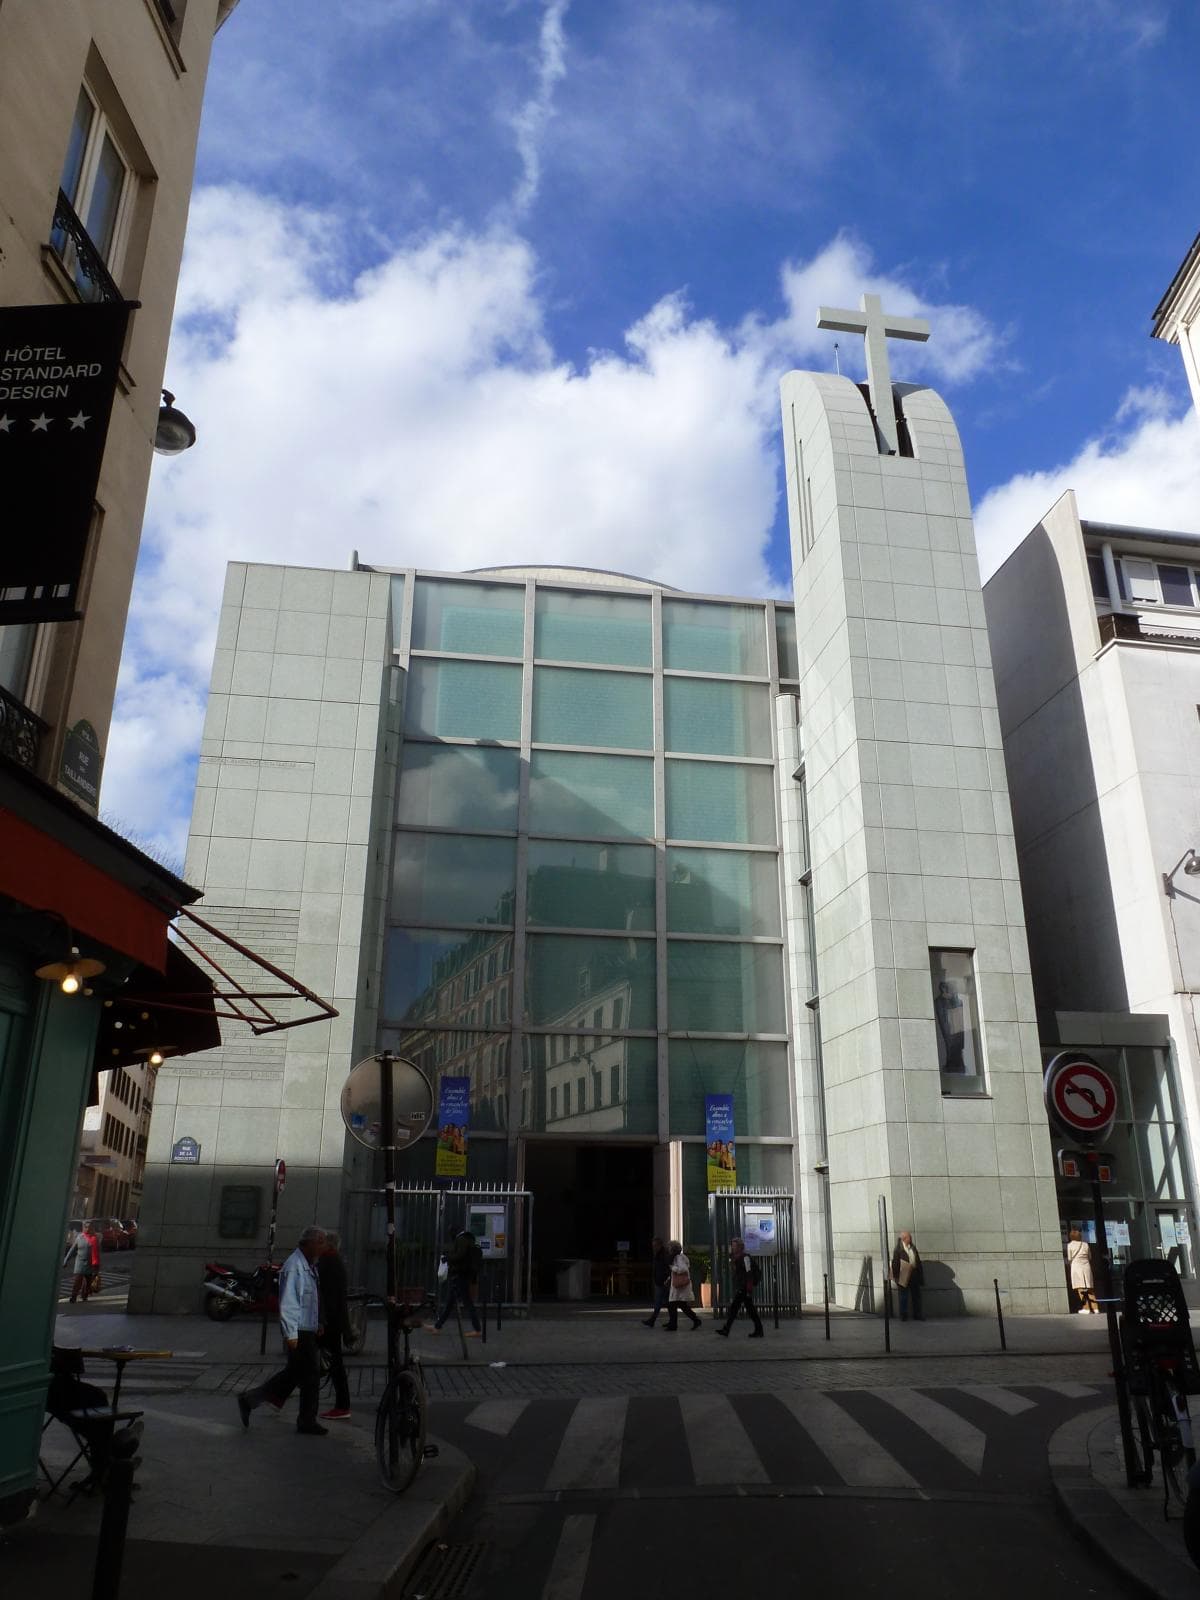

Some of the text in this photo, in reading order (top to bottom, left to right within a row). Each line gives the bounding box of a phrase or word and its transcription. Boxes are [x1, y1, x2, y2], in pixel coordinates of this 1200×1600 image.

[4, 345, 66, 361] HÔTEL
[0, 363, 102, 381] STANDARD
[0, 385, 69, 400] DESIGN
